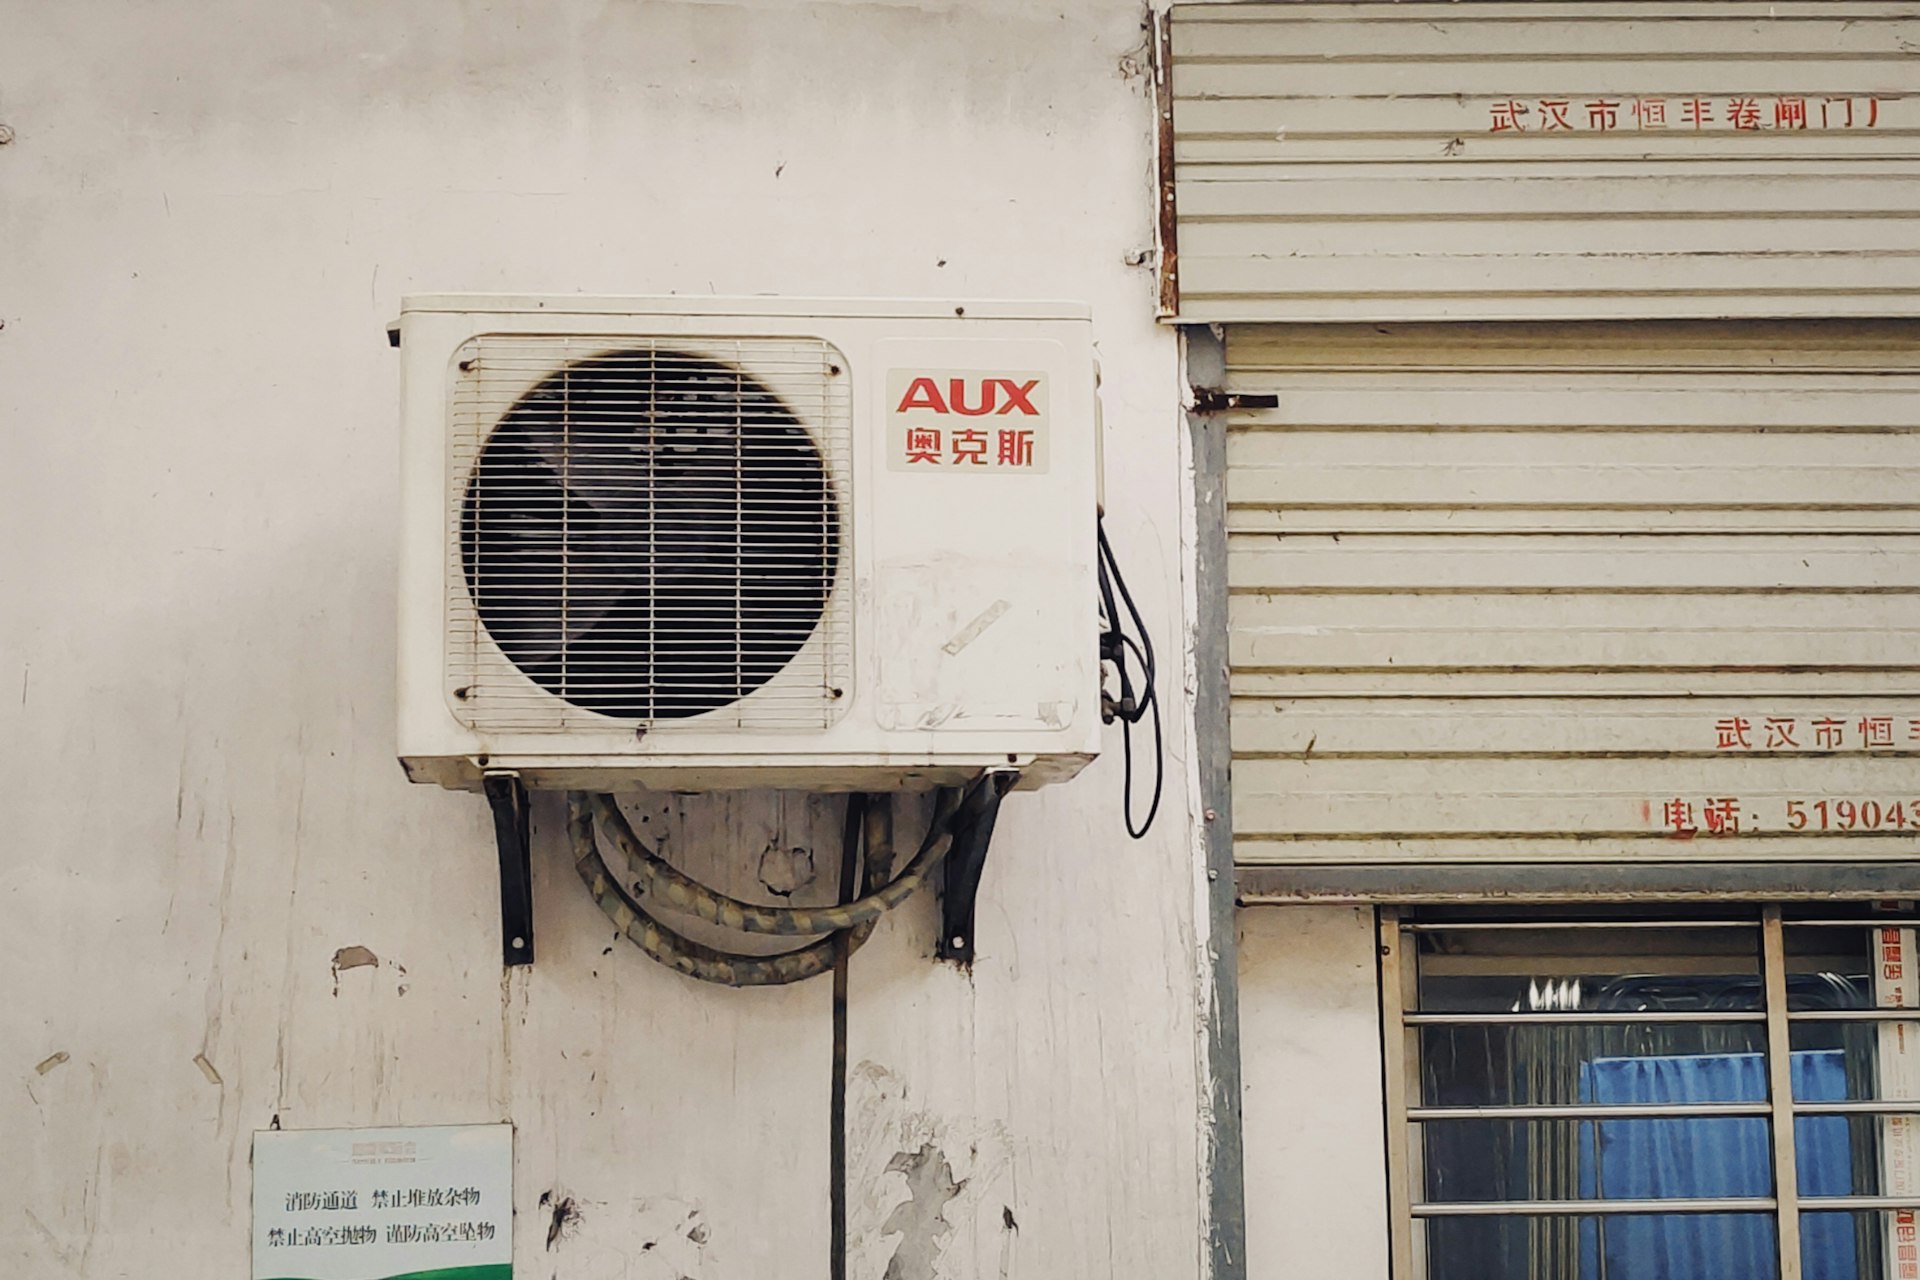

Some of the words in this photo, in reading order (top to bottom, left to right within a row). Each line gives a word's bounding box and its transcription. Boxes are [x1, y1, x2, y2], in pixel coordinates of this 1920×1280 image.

[1489, 97, 1901, 131] 武汉市恒丰卷闸门厂
[896, 377, 1040, 416] AUX
[905, 427, 1034, 466] 奥克斯
[285, 1190, 358, 1211] 消防通道
[371, 1187, 480, 1209] 禁止堆放杂物
[267, 1225, 376, 1247] 禁止高空抛物
[386, 1222, 495, 1243] 谨防高空坠物
